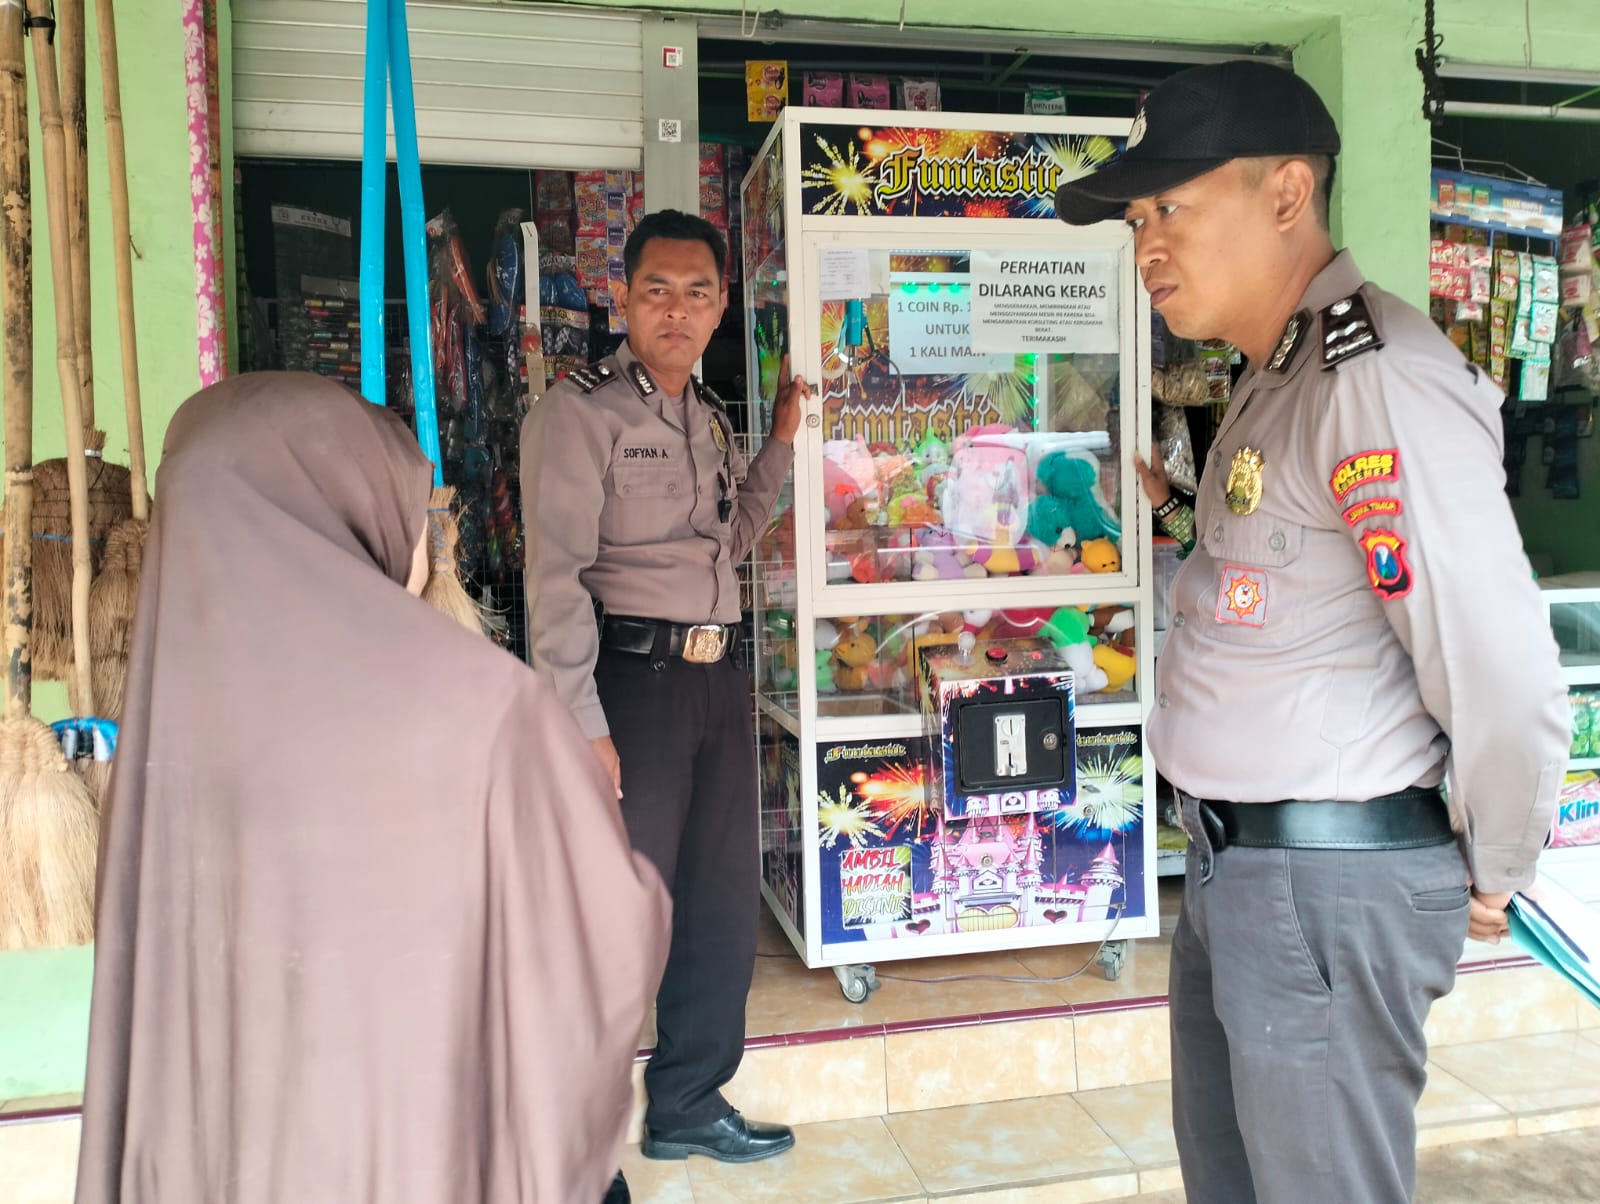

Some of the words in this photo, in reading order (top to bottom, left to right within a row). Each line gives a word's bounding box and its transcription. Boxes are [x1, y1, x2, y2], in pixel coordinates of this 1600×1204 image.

[877, 146, 1064, 200] Funtastic
[1000, 261, 1085, 275] PERHATIAN
[978, 283, 1056, 298] DILARANG
[1060, 285, 1107, 299] KERAS
[897, 302, 904, 312] 1
[908, 301, 940, 313] COIN
[943, 302, 963, 315] Rp.
[925, 323, 970, 335] UNTUK
[1021, 335, 1067, 343] TERIMAKASIH
[909, 346, 916, 358] 1
[920, 346, 947, 358] KALI
[624, 448, 658, 459] SOFYAN
[1076, 731, 1138, 747] untastic
[1559, 798, 1600, 826] Klin
[842, 848, 901, 870] AMBIL
[842, 872, 905, 896] HADIAH
